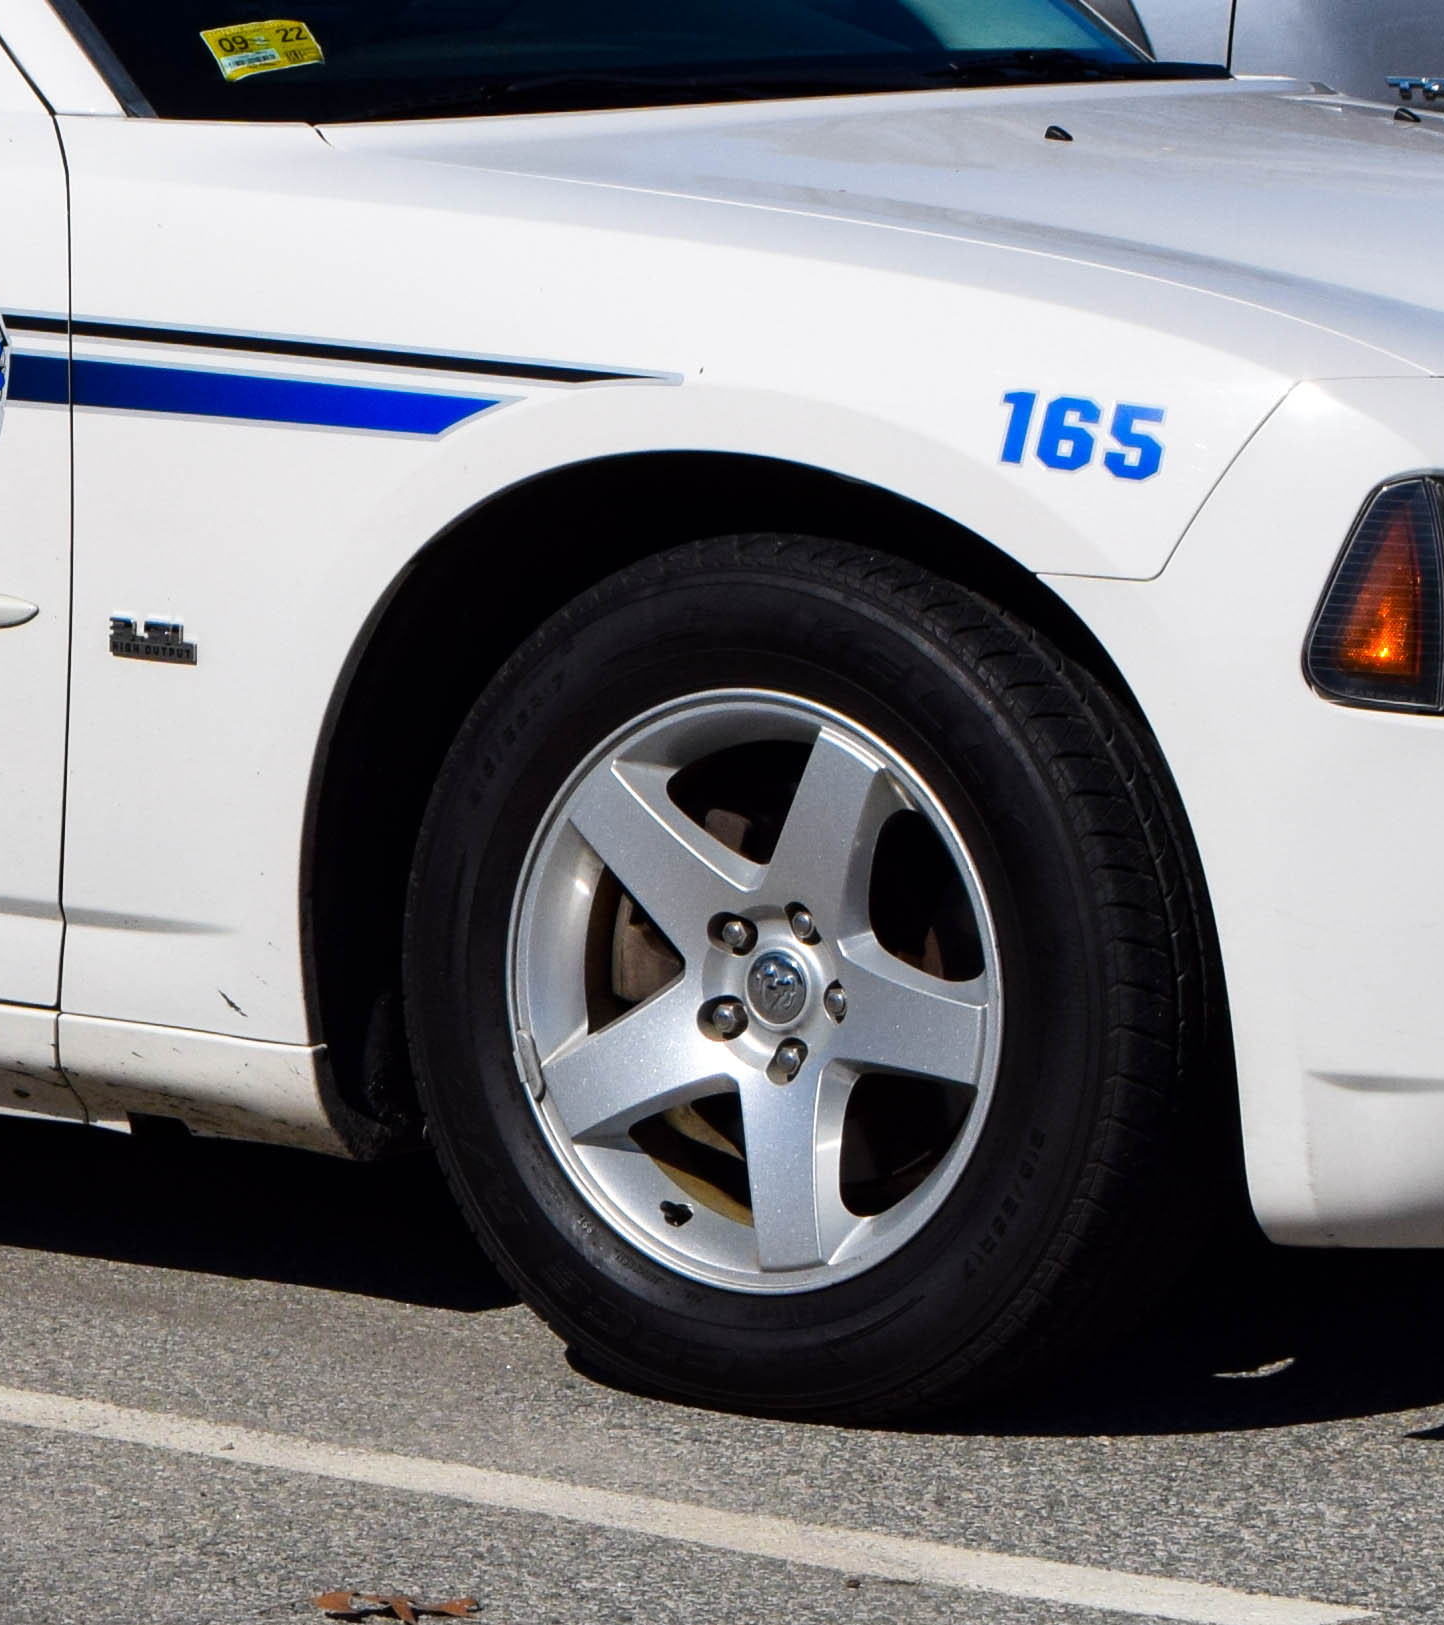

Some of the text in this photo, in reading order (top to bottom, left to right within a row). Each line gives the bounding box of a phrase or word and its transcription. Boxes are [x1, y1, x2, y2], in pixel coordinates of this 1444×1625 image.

[218, 26, 307, 53] 09 22
[1000, 389, 1166, 482] 165
[112, 641, 191, 659] HIGH OUTPUT
